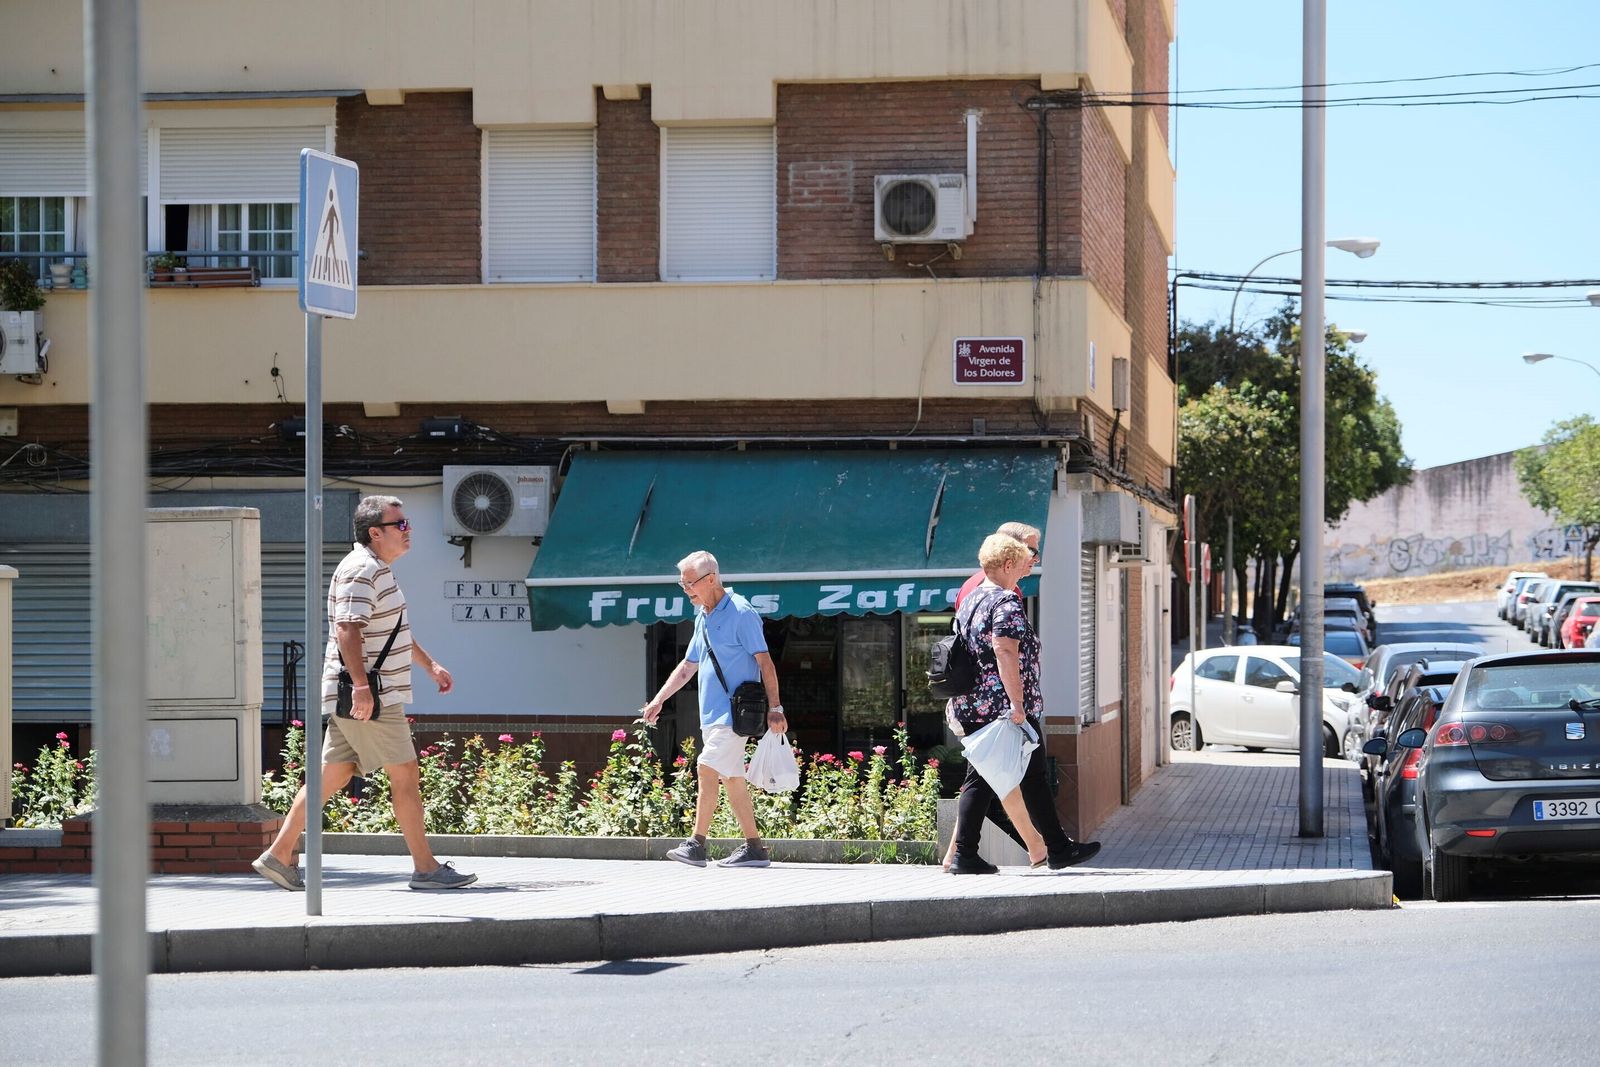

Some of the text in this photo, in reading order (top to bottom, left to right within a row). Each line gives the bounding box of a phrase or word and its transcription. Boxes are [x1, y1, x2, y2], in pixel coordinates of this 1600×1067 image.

[979, 345, 1015, 353] Avenida
[968, 356, 1011, 367] Virgen de
[964, 368, 1015, 377] los Dolores
[456, 583, 528, 597] FRUT
[465, 606, 526, 620] ZAFR
[588, 590, 780, 622] Frus
[1548, 801, 1588, 817] 3392
